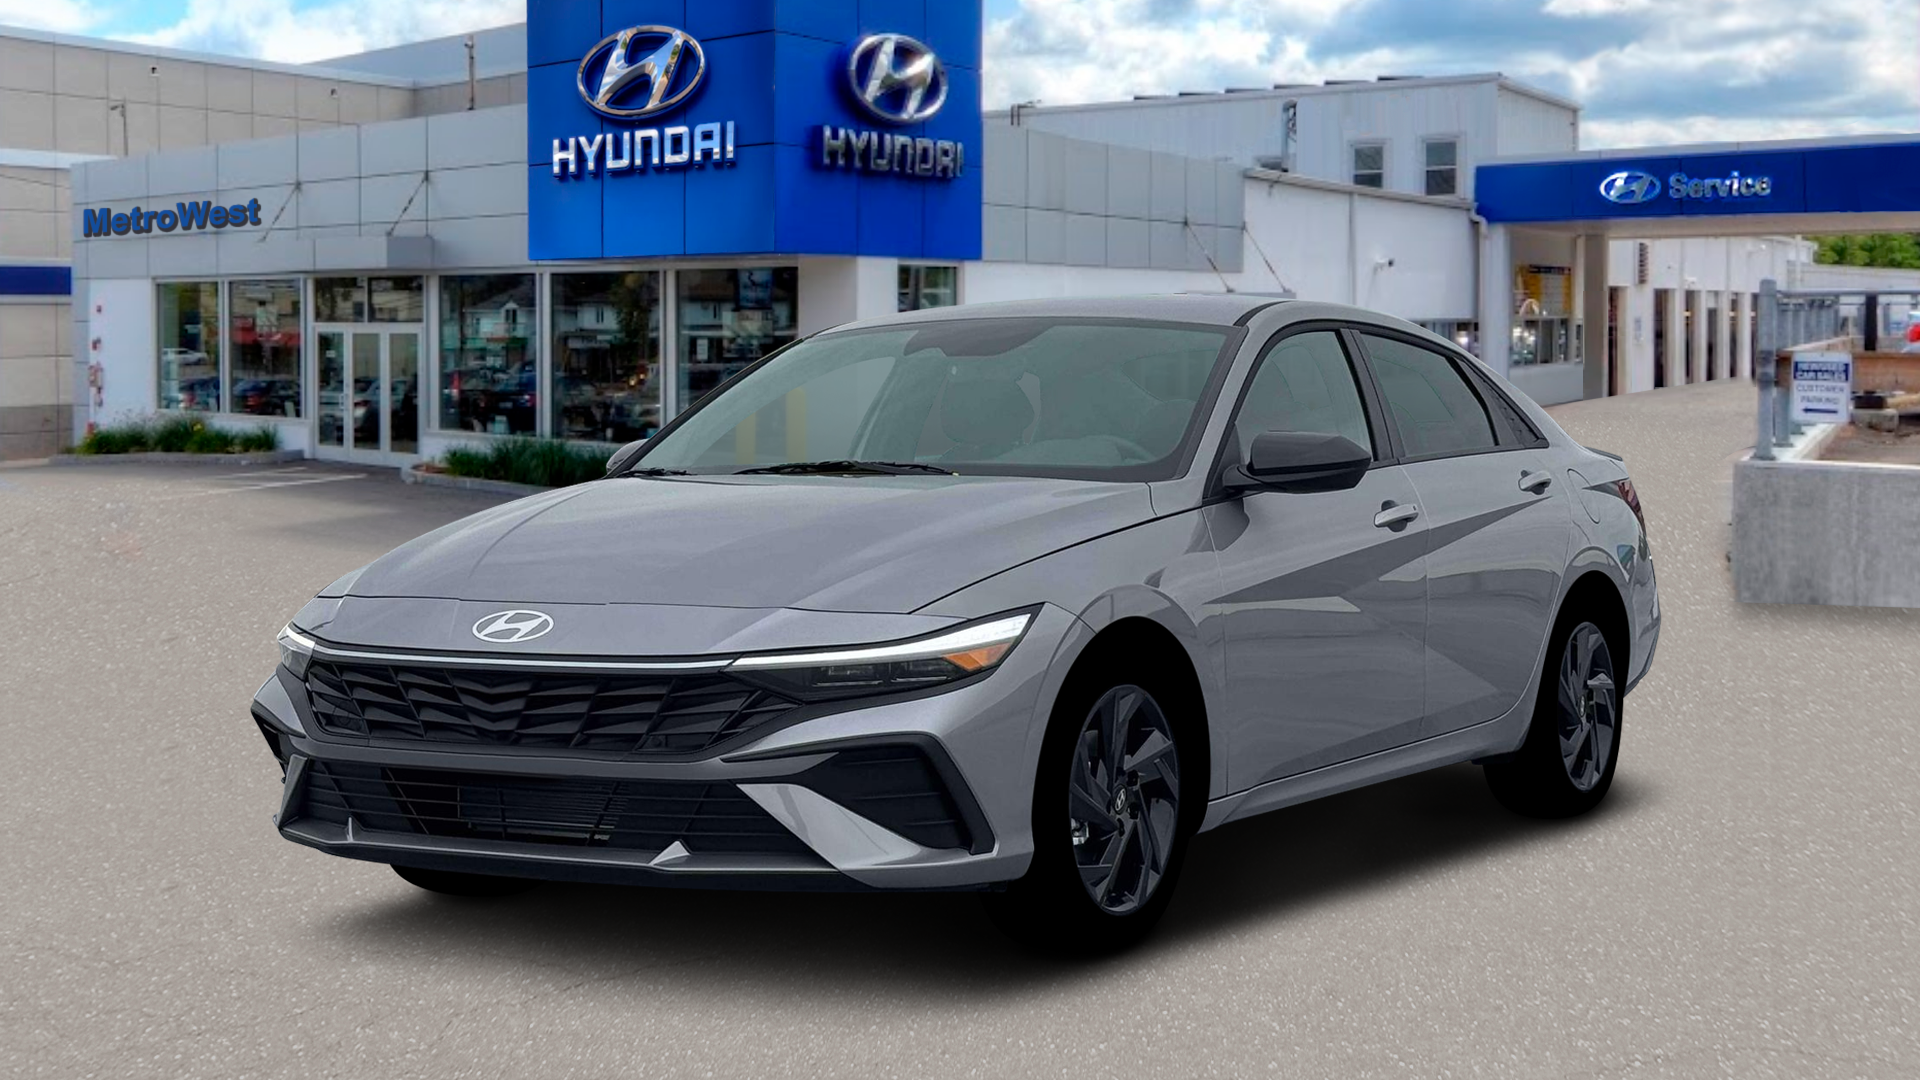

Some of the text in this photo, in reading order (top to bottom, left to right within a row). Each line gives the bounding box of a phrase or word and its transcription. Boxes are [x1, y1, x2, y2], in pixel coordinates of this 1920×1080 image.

[553, 121, 736, 176] HYUNDAI
[823, 125, 964, 178] HYUNDAI
[1669, 171, 1772, 199] Service
[82, 198, 261, 237] MetroWest
[1796, 384, 1845, 394] CUSTOMER
[1800, 395, 1840, 404] PARKING
